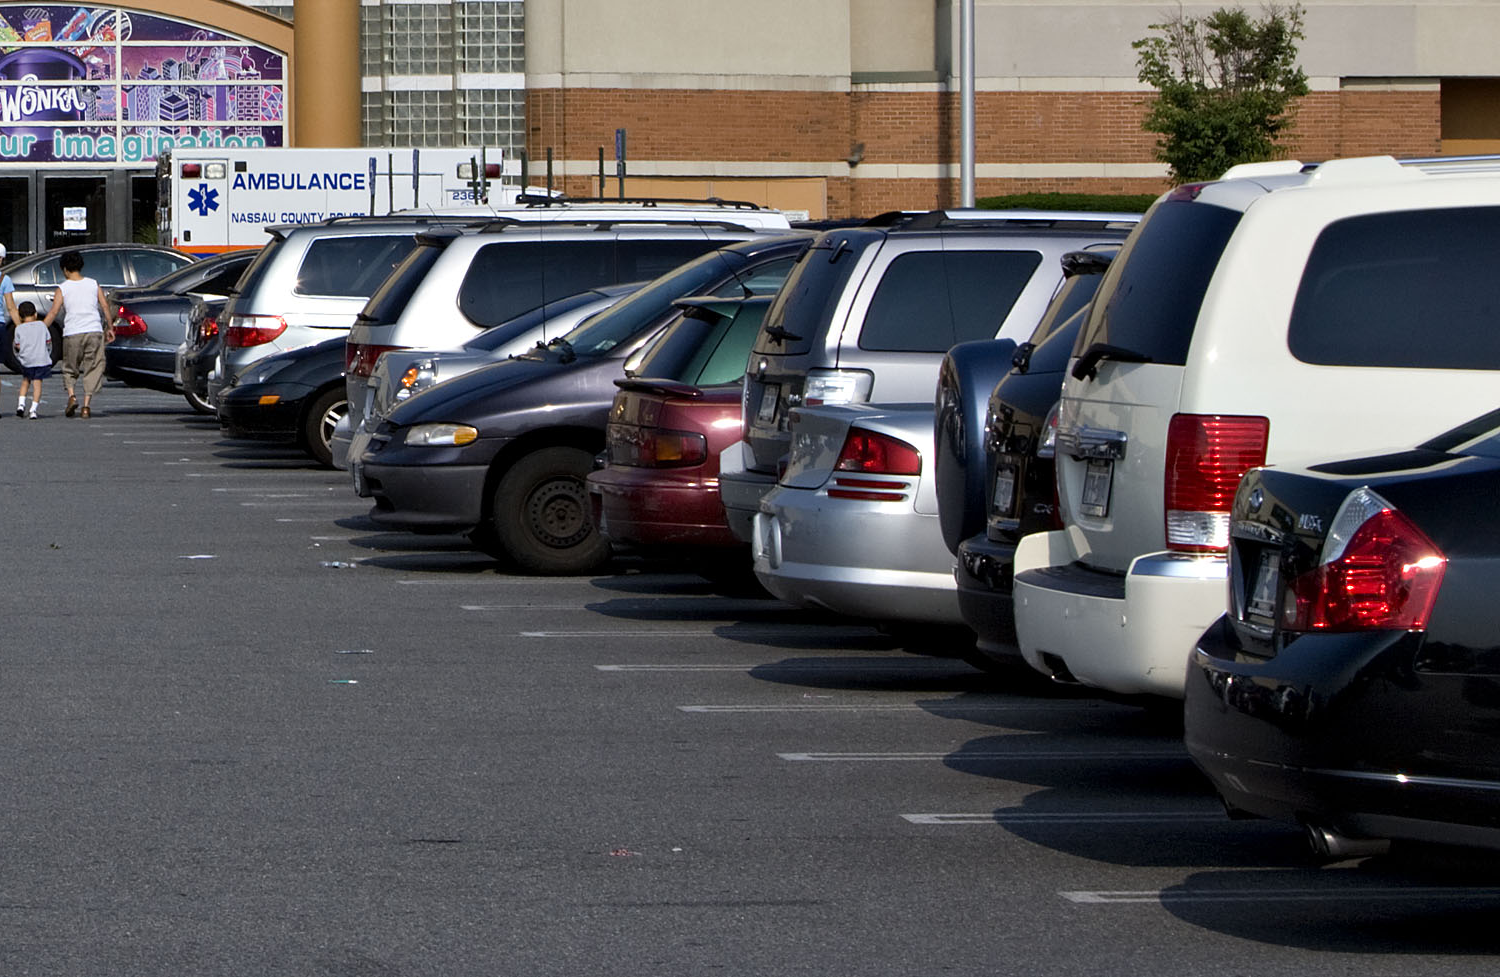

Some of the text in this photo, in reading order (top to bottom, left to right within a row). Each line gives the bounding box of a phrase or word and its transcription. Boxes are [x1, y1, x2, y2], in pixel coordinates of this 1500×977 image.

[232, 173, 366, 190] AMBULANCE
[231, 212, 278, 224] NASSAU
[281, 212, 327, 223] COUNTY
